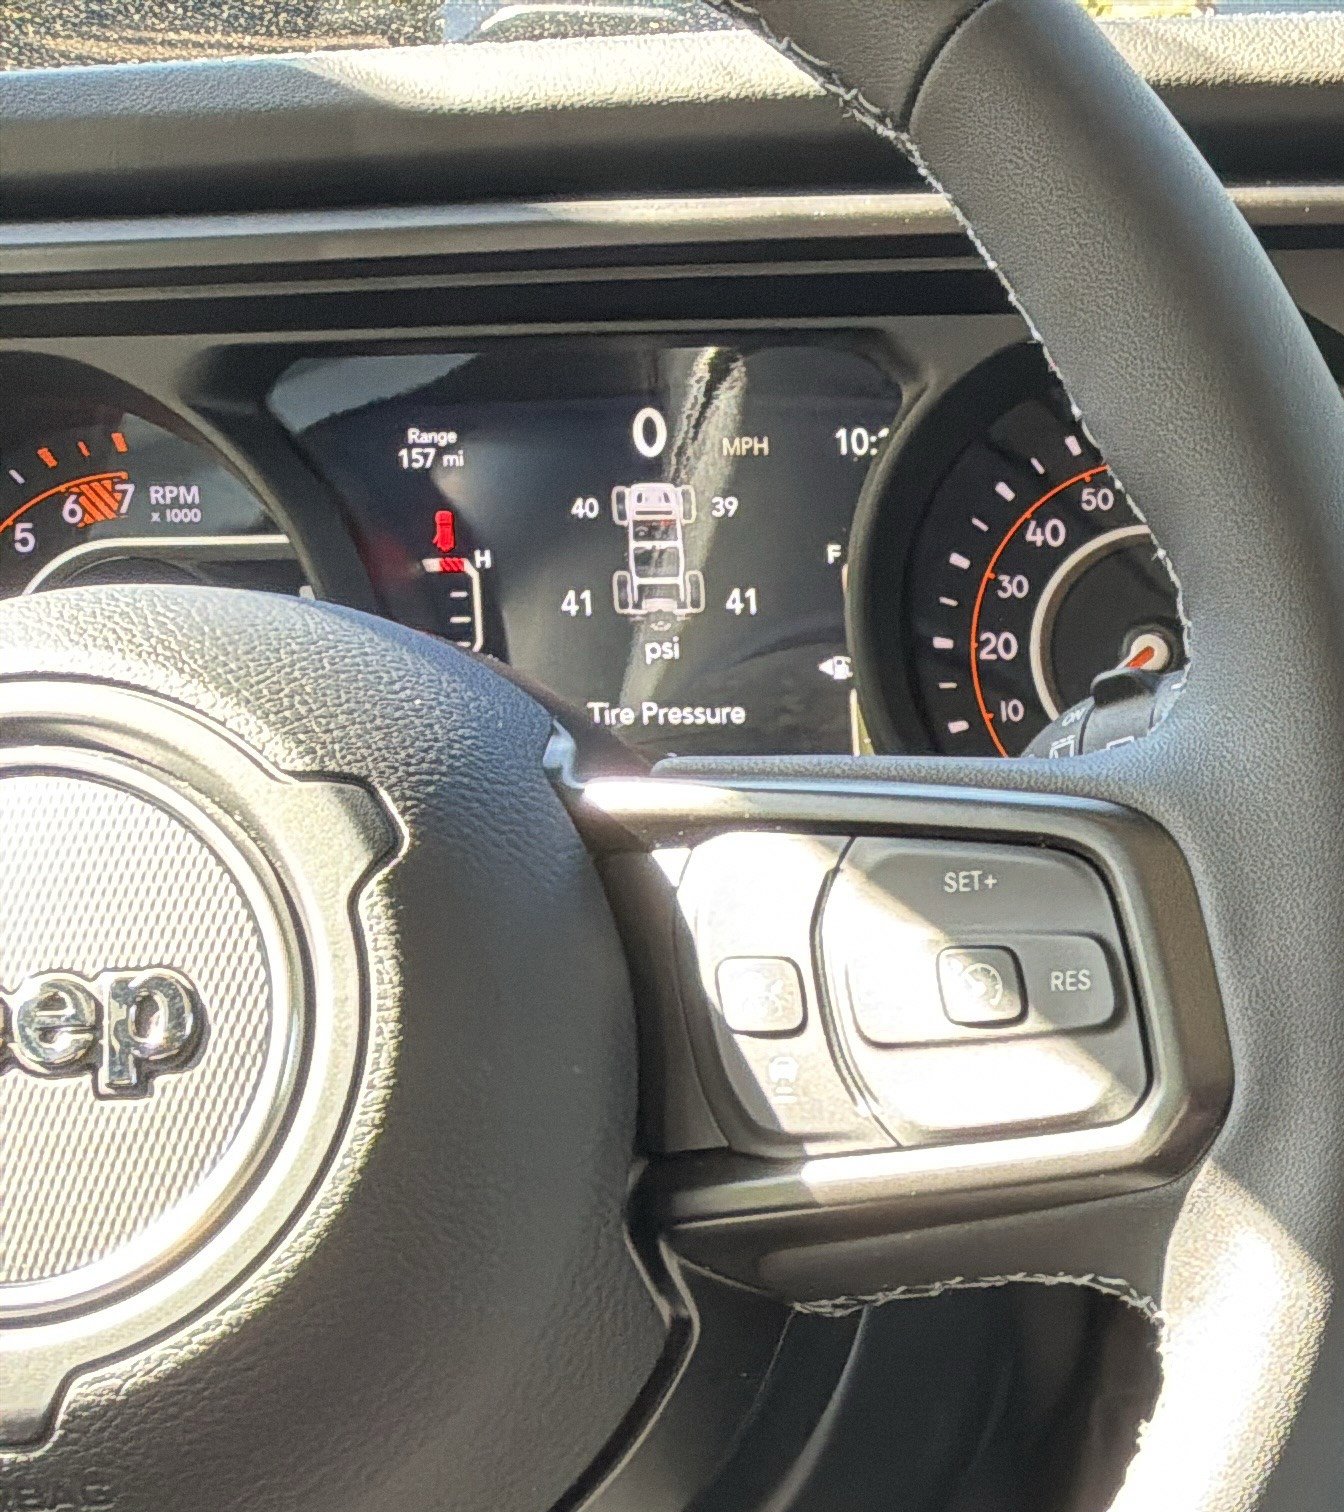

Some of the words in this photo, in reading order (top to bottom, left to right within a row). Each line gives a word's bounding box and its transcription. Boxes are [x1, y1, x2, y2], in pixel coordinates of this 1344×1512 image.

[407, 428, 458, 446] Range
[632, 406, 668, 458] 0
[398, 449, 435, 469] 157
[442, 450, 465, 468] mi
[722, 436, 770, 457] MPH
[115, 484, 135, 514] 7
[150, 485, 200, 505] RPM
[711, 497, 739, 518] 39
[1081, 487, 1114, 512] 50
[62, 495, 83, 524] 6
[166, 508, 202, 523] 1000
[570, 497, 600, 519] 40
[14, 522, 36, 553] 5
[1025, 518, 1066, 548] 40
[474, 550, 492, 569] H
[826, 544, 842, 565] F
[997, 574, 1029, 599] 30
[560, 589, 593, 617] 41
[725, 588, 758, 616] 41
[644, 635, 681, 664] psi
[979, 631, 1018, 661] 20
[587, 700, 636, 725] Tire
[641, 701, 746, 725] Pressure
[999, 698, 1024, 722] 10
[943, 871, 998, 893] SET+
[1050, 969, 1092, 992] RES
[0, 974, 195, 1086] ep
